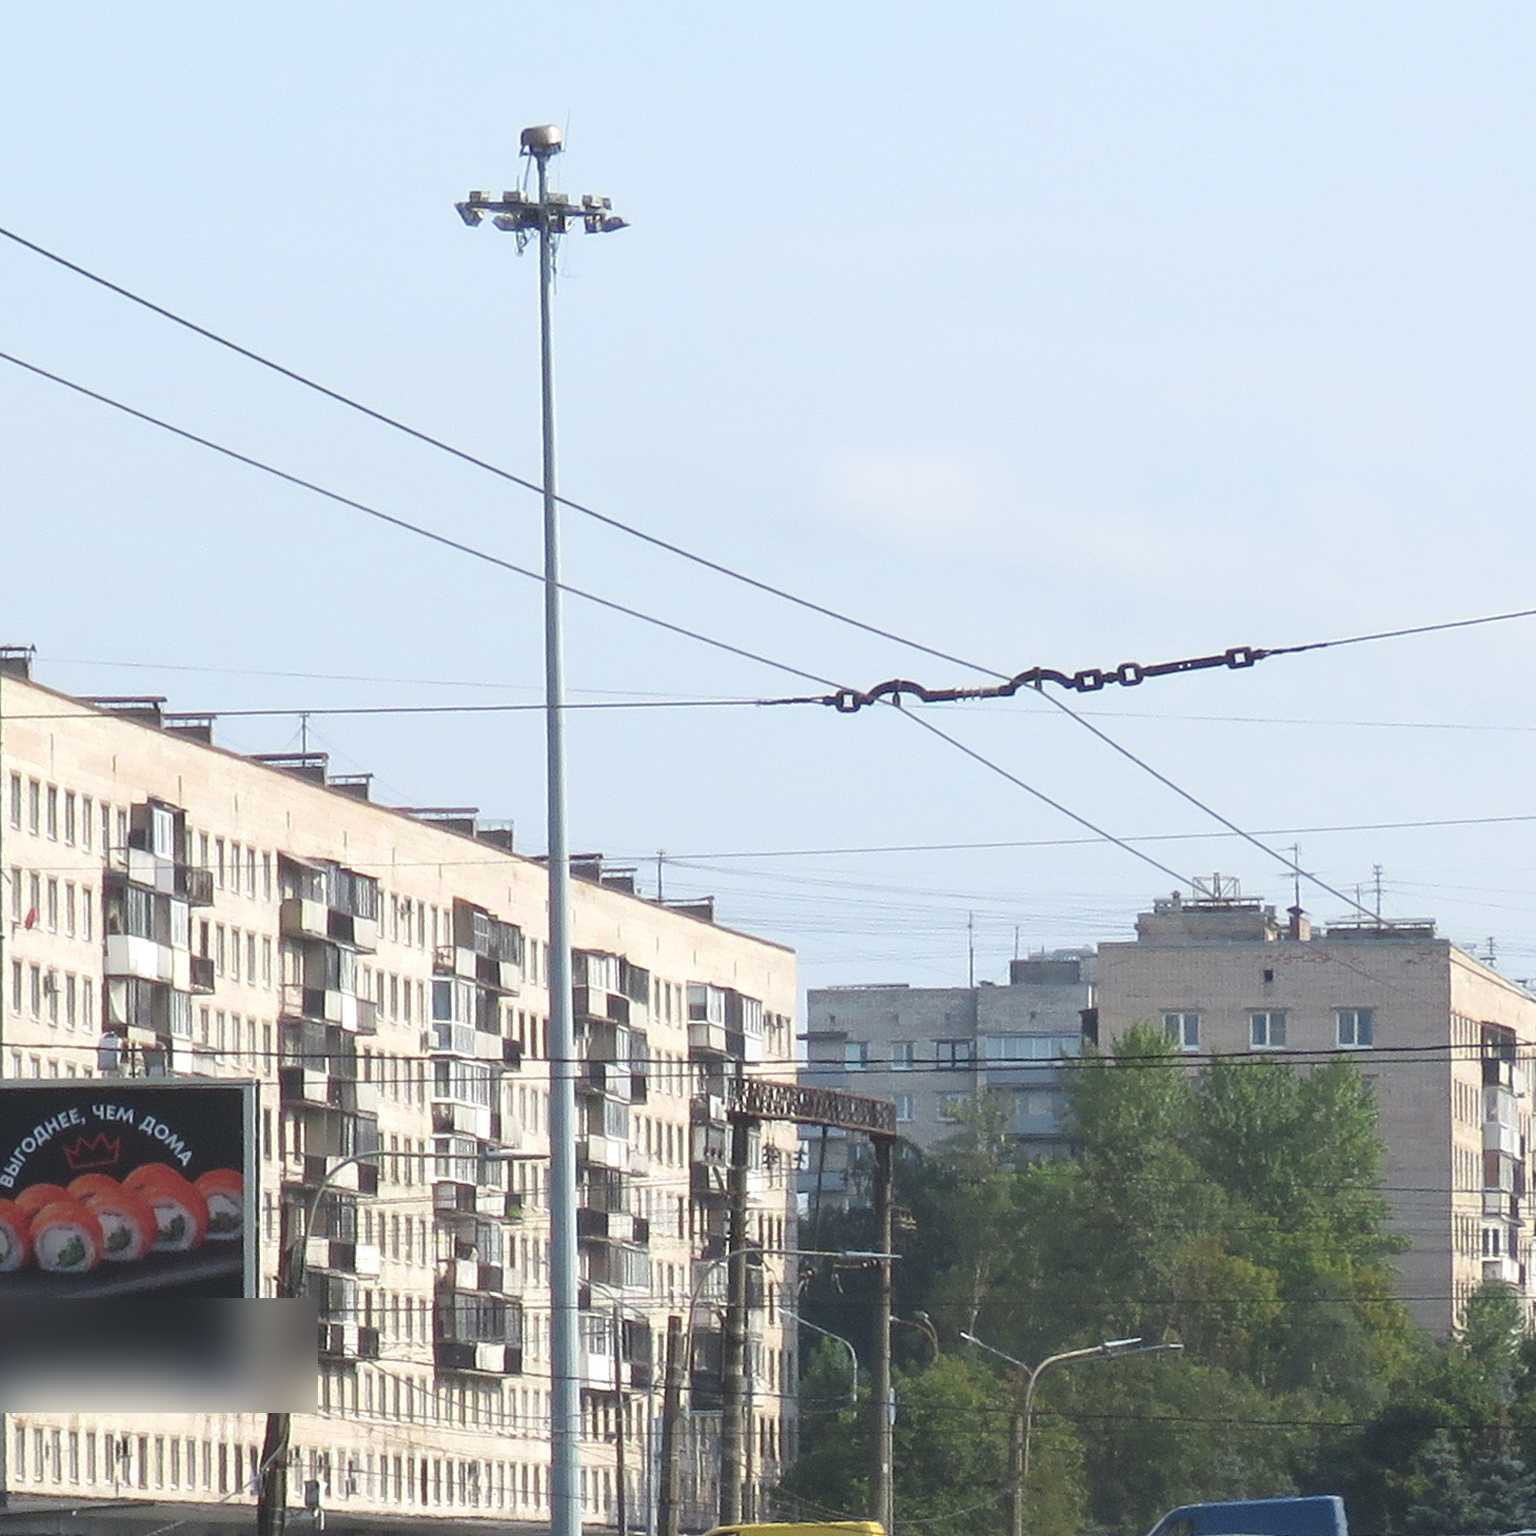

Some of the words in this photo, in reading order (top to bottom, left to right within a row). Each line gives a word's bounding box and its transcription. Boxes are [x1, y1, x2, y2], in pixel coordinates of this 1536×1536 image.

[0, 1108, 86, 1188] ВЫГОДНЕЕ,
[92, 1104, 136, 1124] ЧЕМ
[138, 1115, 193, 1167] ДОМА
